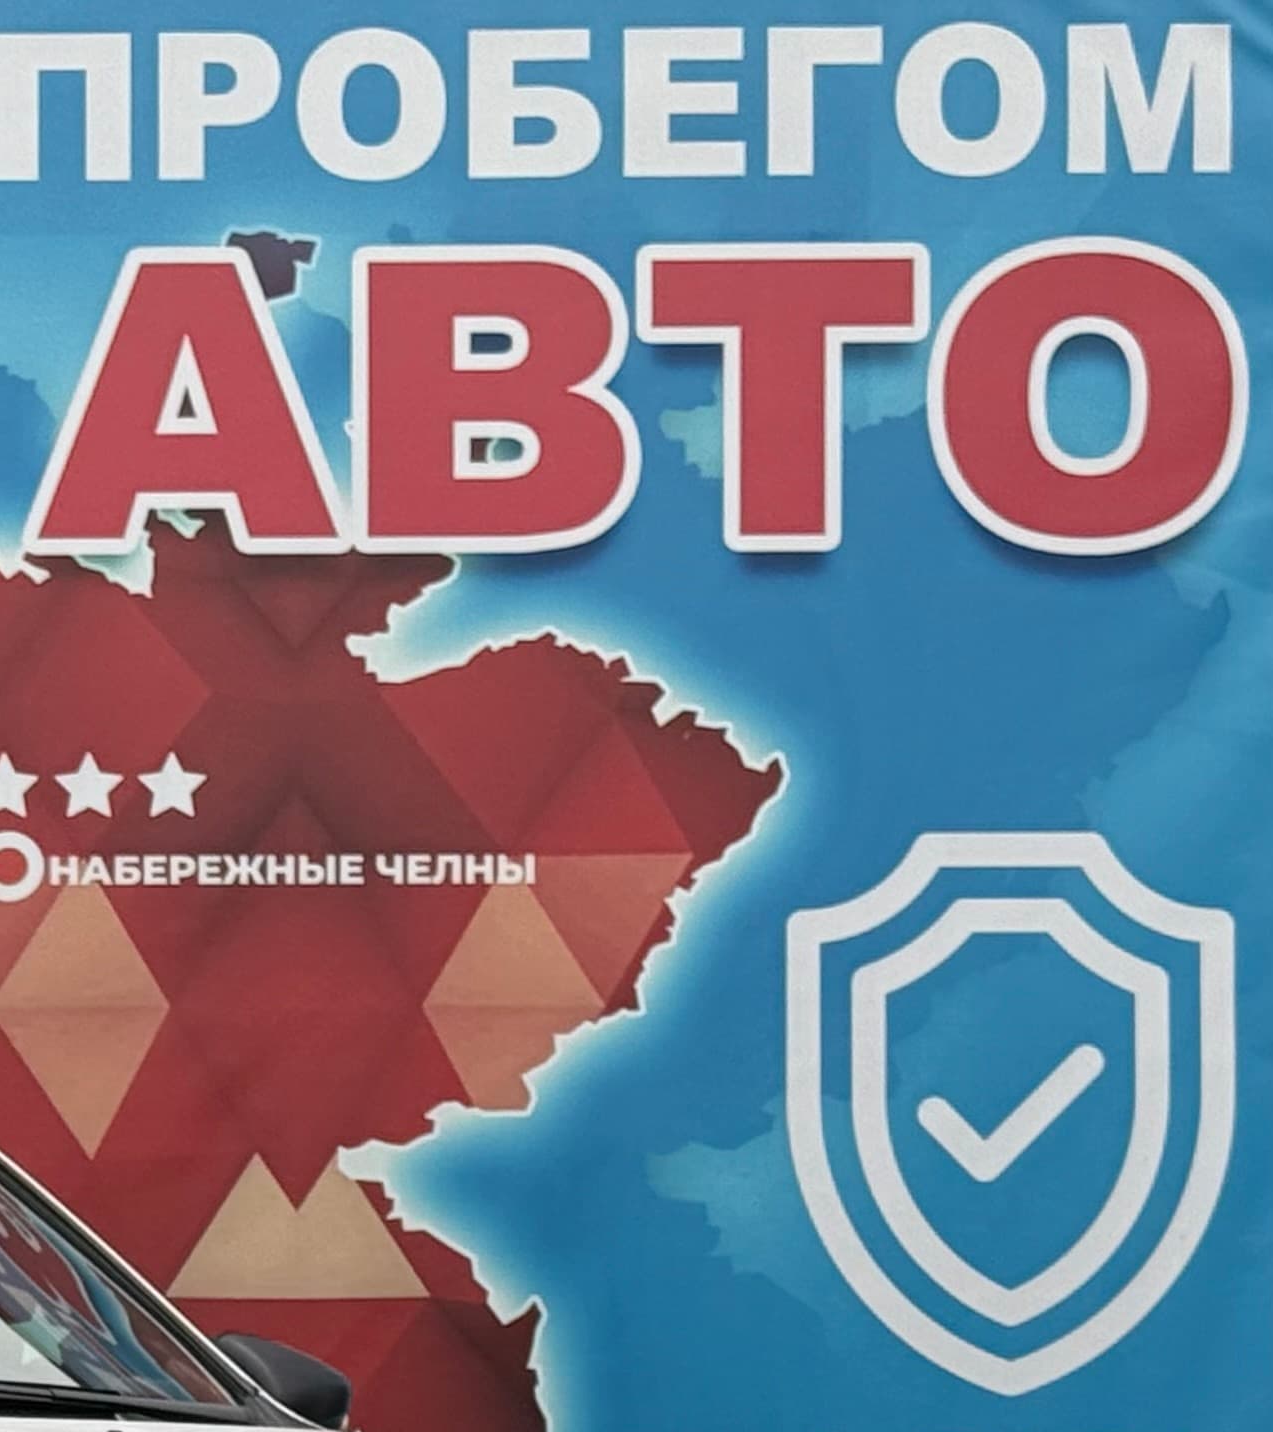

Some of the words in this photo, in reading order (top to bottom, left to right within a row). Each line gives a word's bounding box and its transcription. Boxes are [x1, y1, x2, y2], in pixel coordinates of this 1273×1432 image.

[22, 236, 1249, 556] АВТО
[49, 854, 365, 887] НАБЕРЕЖНЫЕ
[375, 853, 536, 886] ЧЕЛНЫ
